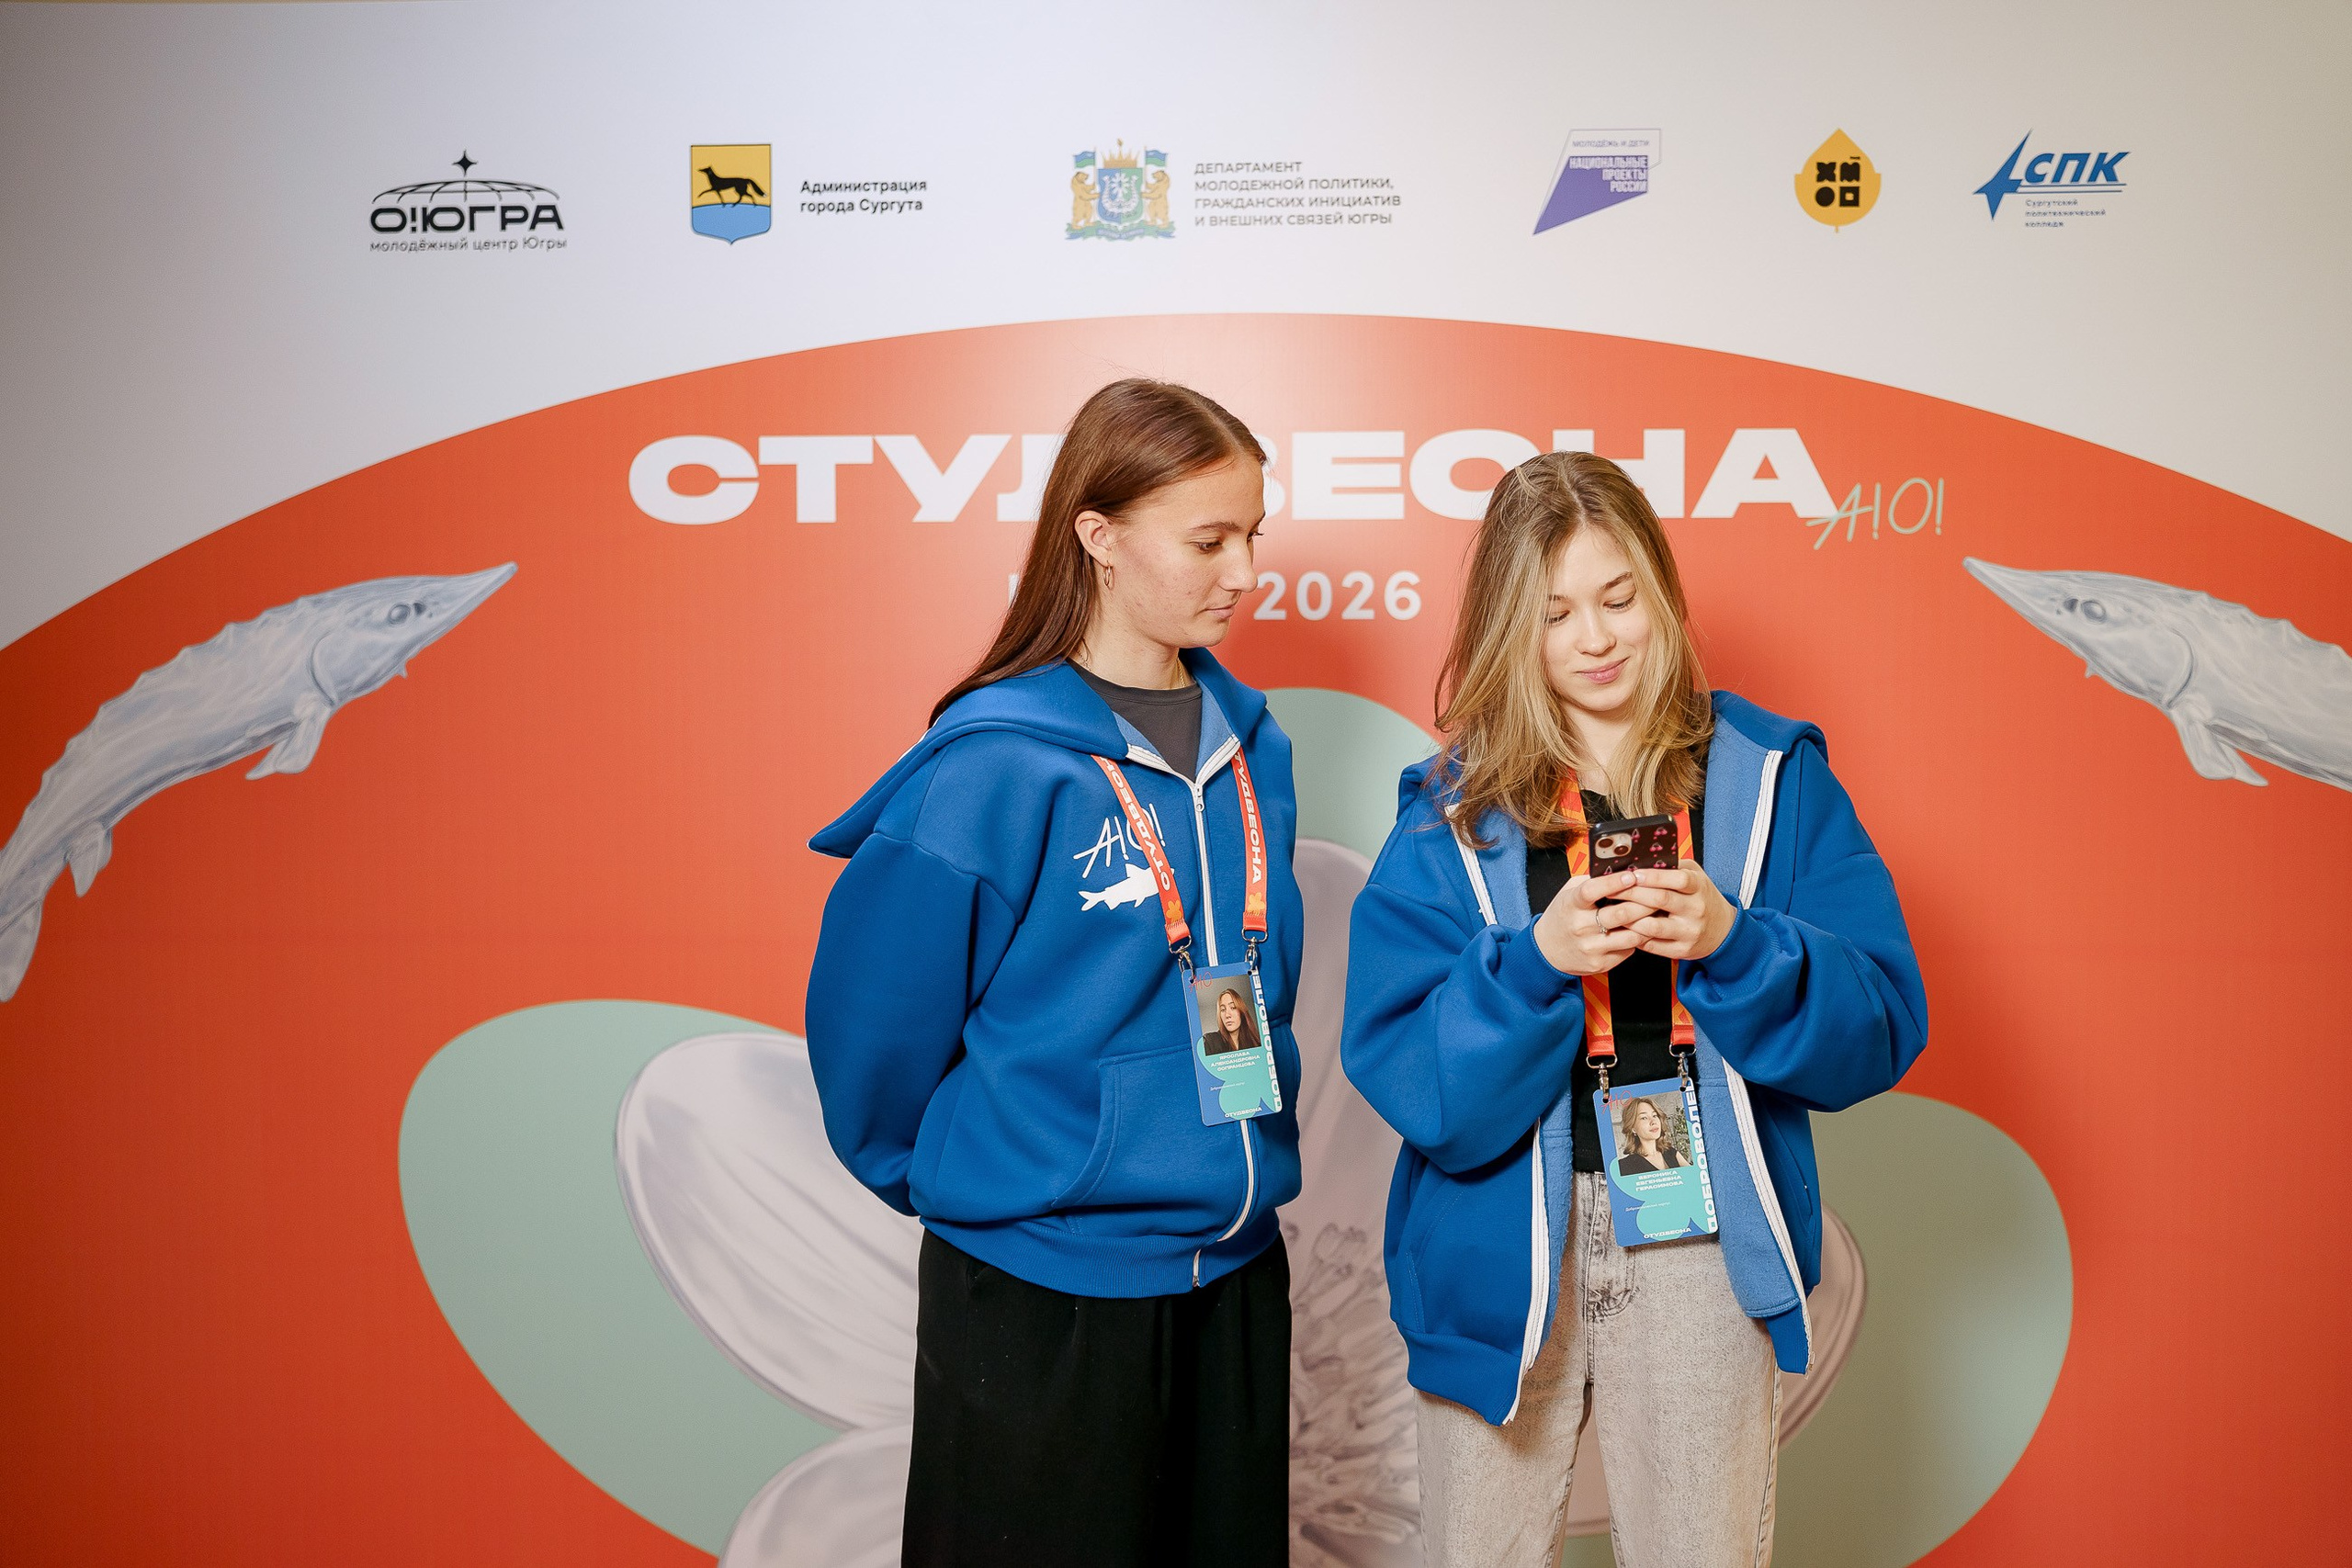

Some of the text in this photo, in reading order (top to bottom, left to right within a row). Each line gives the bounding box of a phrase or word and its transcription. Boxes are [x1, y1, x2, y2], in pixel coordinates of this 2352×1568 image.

[1194, 162, 1302, 175] ДЕПАРТАМЕНТ
[1569, 156, 1647, 170] НАЦИОНАЛЬНЫЕ
[2024, 152, 2131, 184] СПК
[1601, 168, 1647, 181] ПРОЕКТЫ
[800, 181, 927, 195] Администрация
[1194, 177, 1395, 191] МОЛОДЕЖНОЙ ПОЛИТИКИ,
[1610, 180, 1647, 193] РОССИИ
[800, 198, 923, 215] города Сургута
[1194, 195, 1401, 209] ГРАЖДАНСКИХ ИНИЦИАТИВ
[1194, 211, 1393, 227] И ВНЕШНИХ СВЯЗЕЙ ЮГРЫ
[369, 236, 568, 253] молодёжный центр Югры
[1252, 570, 1422, 621] 2026
